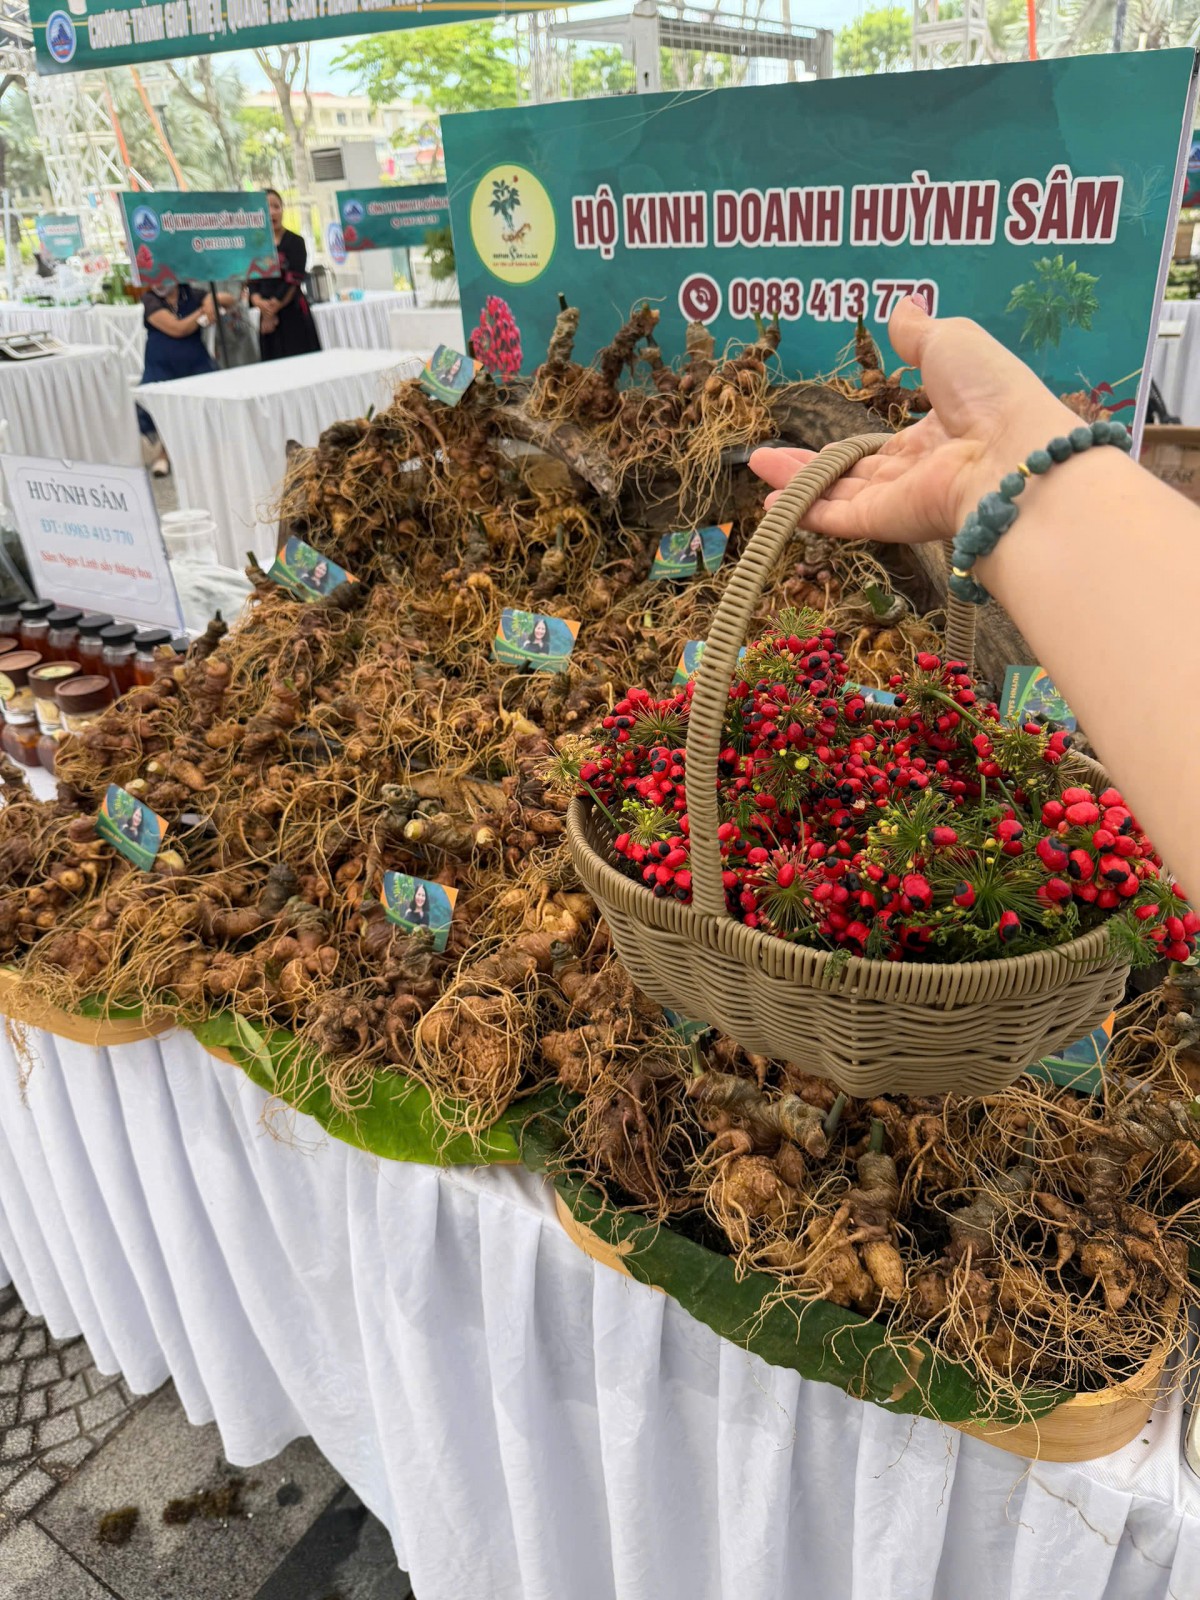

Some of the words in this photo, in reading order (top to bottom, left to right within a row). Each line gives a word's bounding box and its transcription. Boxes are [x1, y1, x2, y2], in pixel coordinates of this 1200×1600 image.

[573, 185, 618, 259] HỘ
[624, 192, 707, 248] KINH
[714, 188, 843, 247] DOANH
[851, 171, 999, 246] HUỲNH
[1005, 165, 1122, 245] SÂM
[729, 278, 803, 320] 0983
[807, 279, 868, 322] 413
[26, 478, 89, 506] HUỲNH
[89, 484, 129, 512] SÂM
